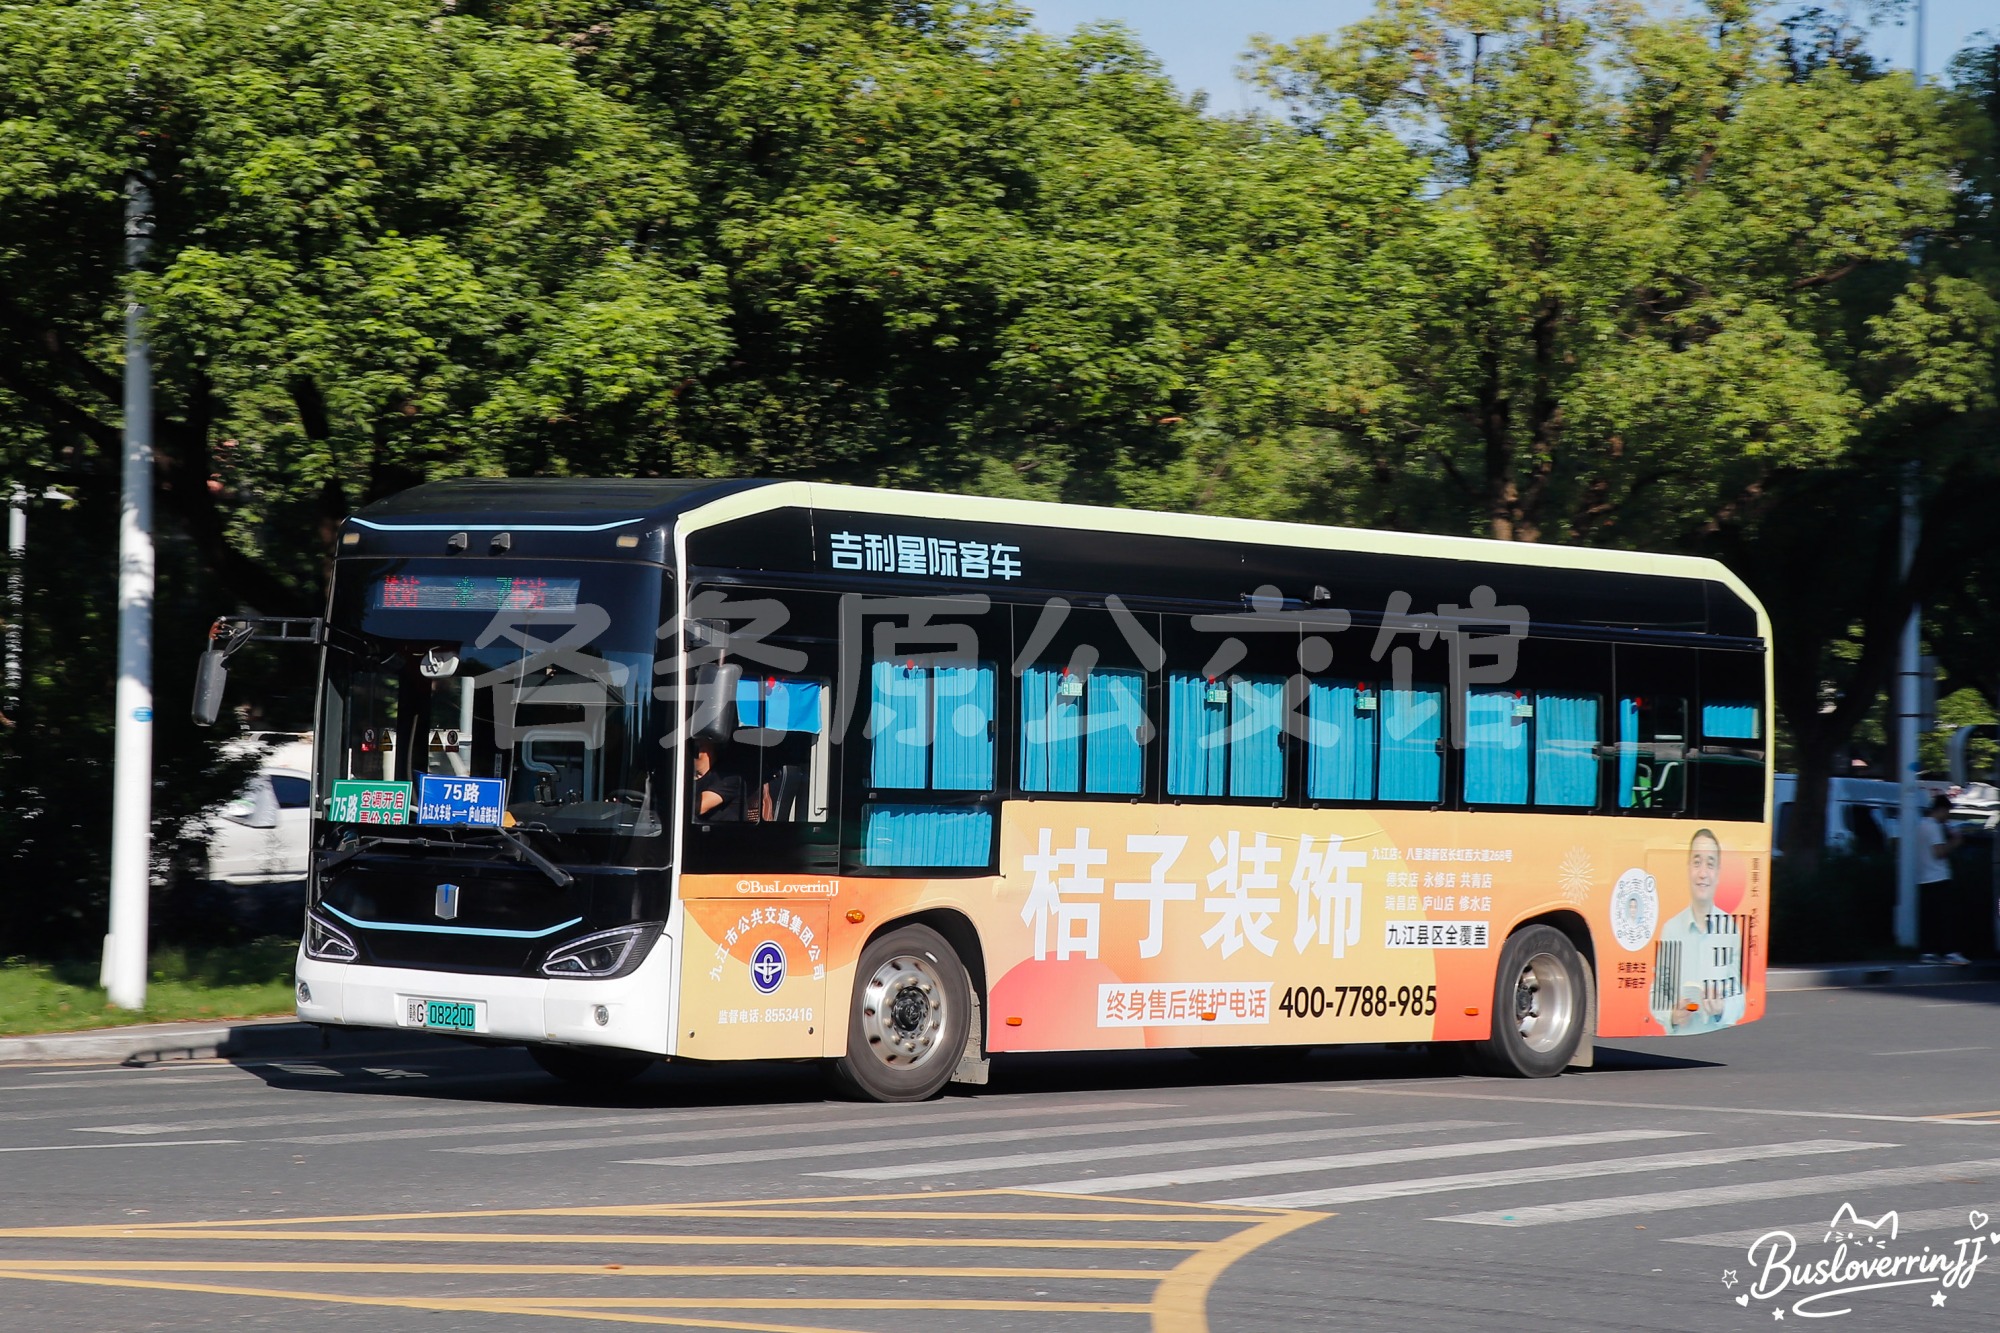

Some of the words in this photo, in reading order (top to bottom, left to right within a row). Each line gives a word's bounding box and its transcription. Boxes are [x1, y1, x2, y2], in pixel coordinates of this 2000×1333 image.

[830, 531, 1021, 580] 吉利星际客车
[360, 790, 404, 808] 空调开启
[443, 783, 480, 803] 75路
[334, 793, 358, 822] 75路
[1387, 872, 1419, 888] 德安店
[1423, 872, 1456, 888] 永修店
[1460, 873, 1493, 888] 共青店
[1021, 827, 1367, 961] 桔子装饰
[1422, 895, 1454, 911] 庐山店
[1459, 896, 1491, 912] 修水店
[709, 907, 825, 982] 九江市公共交通集团公司
[1387, 924, 1486, 946] 九江县区全覆盖
[1105, 988, 1267, 1022] 终身售后维护电话
[1278, 985, 1437, 1019] 400-7788-985
[430, 1004, 474, 1027] 08220D
